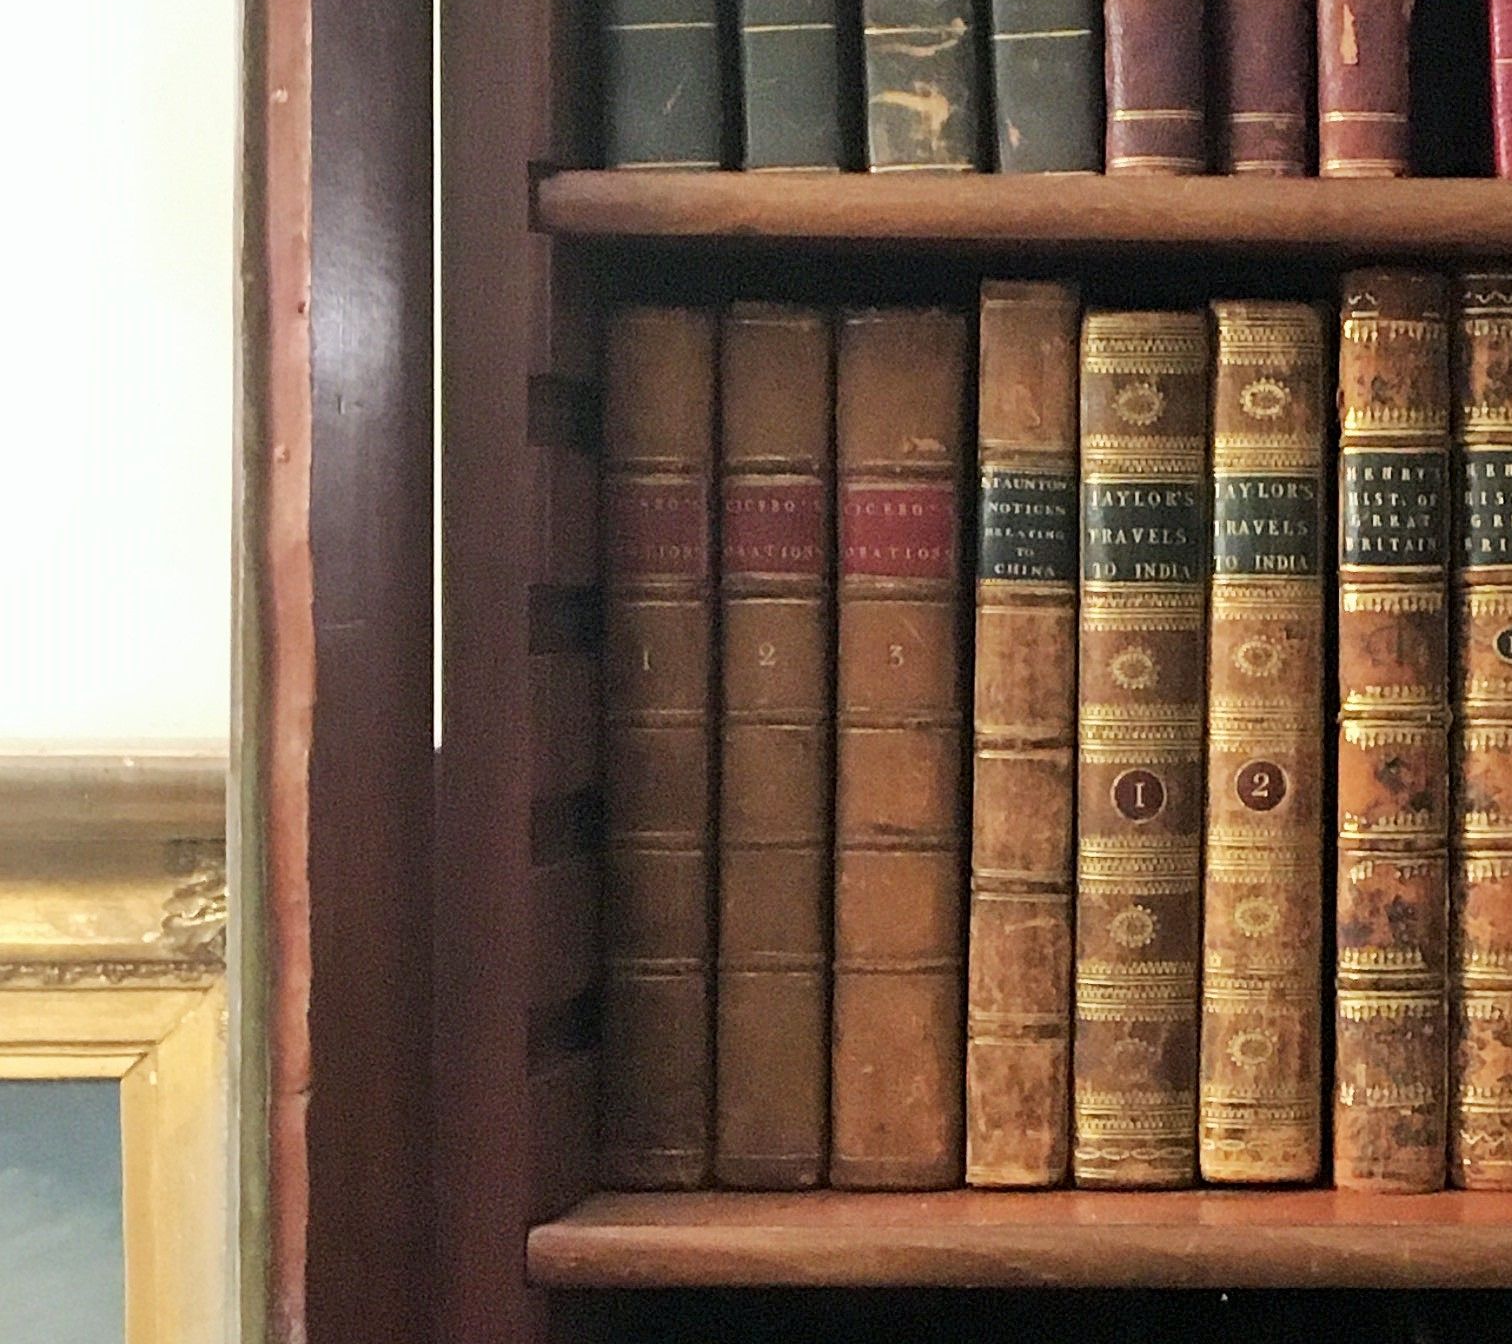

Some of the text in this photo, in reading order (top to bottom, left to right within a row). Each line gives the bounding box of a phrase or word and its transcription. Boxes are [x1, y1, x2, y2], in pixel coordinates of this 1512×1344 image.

[1090, 490, 1194, 510] TAYLOR'S
[1016, 547, 1034, 556] TO
[994, 563, 1055, 576] CHINA
[1092, 561, 1191, 580] TO INDIA
[1255, 553, 1308, 571] INDIA
[759, 642, 776, 666] 2
[889, 645, 904, 668] 3
[1251, 772, 1269, 798] 2
